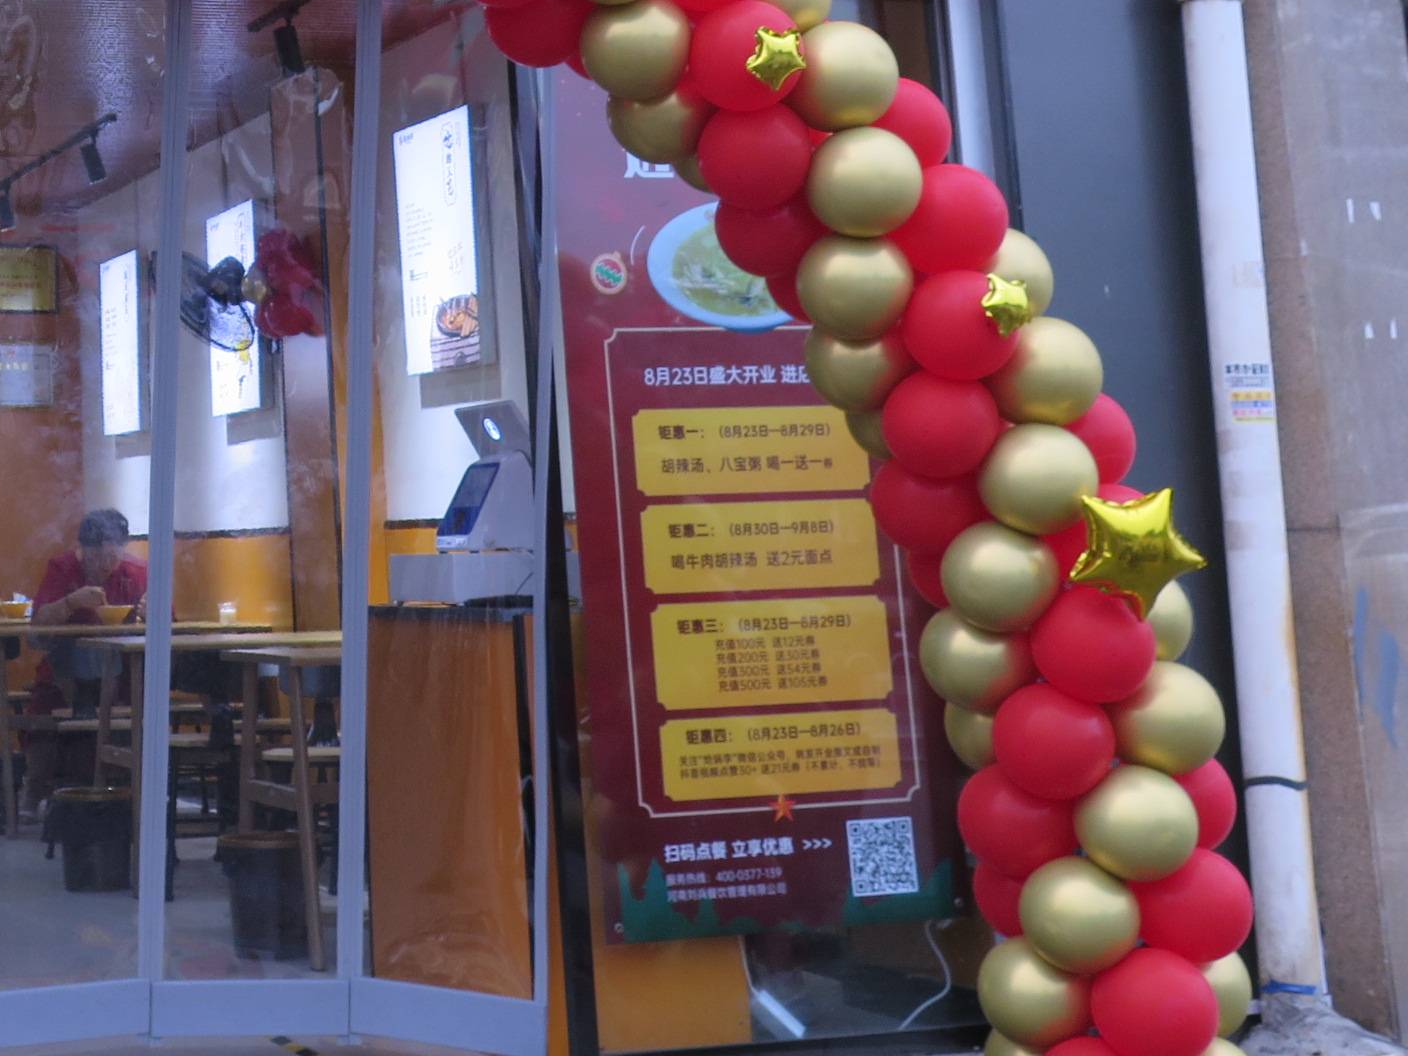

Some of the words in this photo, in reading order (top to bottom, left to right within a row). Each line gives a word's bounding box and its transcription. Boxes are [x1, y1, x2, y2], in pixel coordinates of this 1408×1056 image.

[644, 364, 777, 386] 8月23日盛大开业
[664, 841, 727, 862] 扫码点餐
[731, 837, 795, 858] 立享优惠
